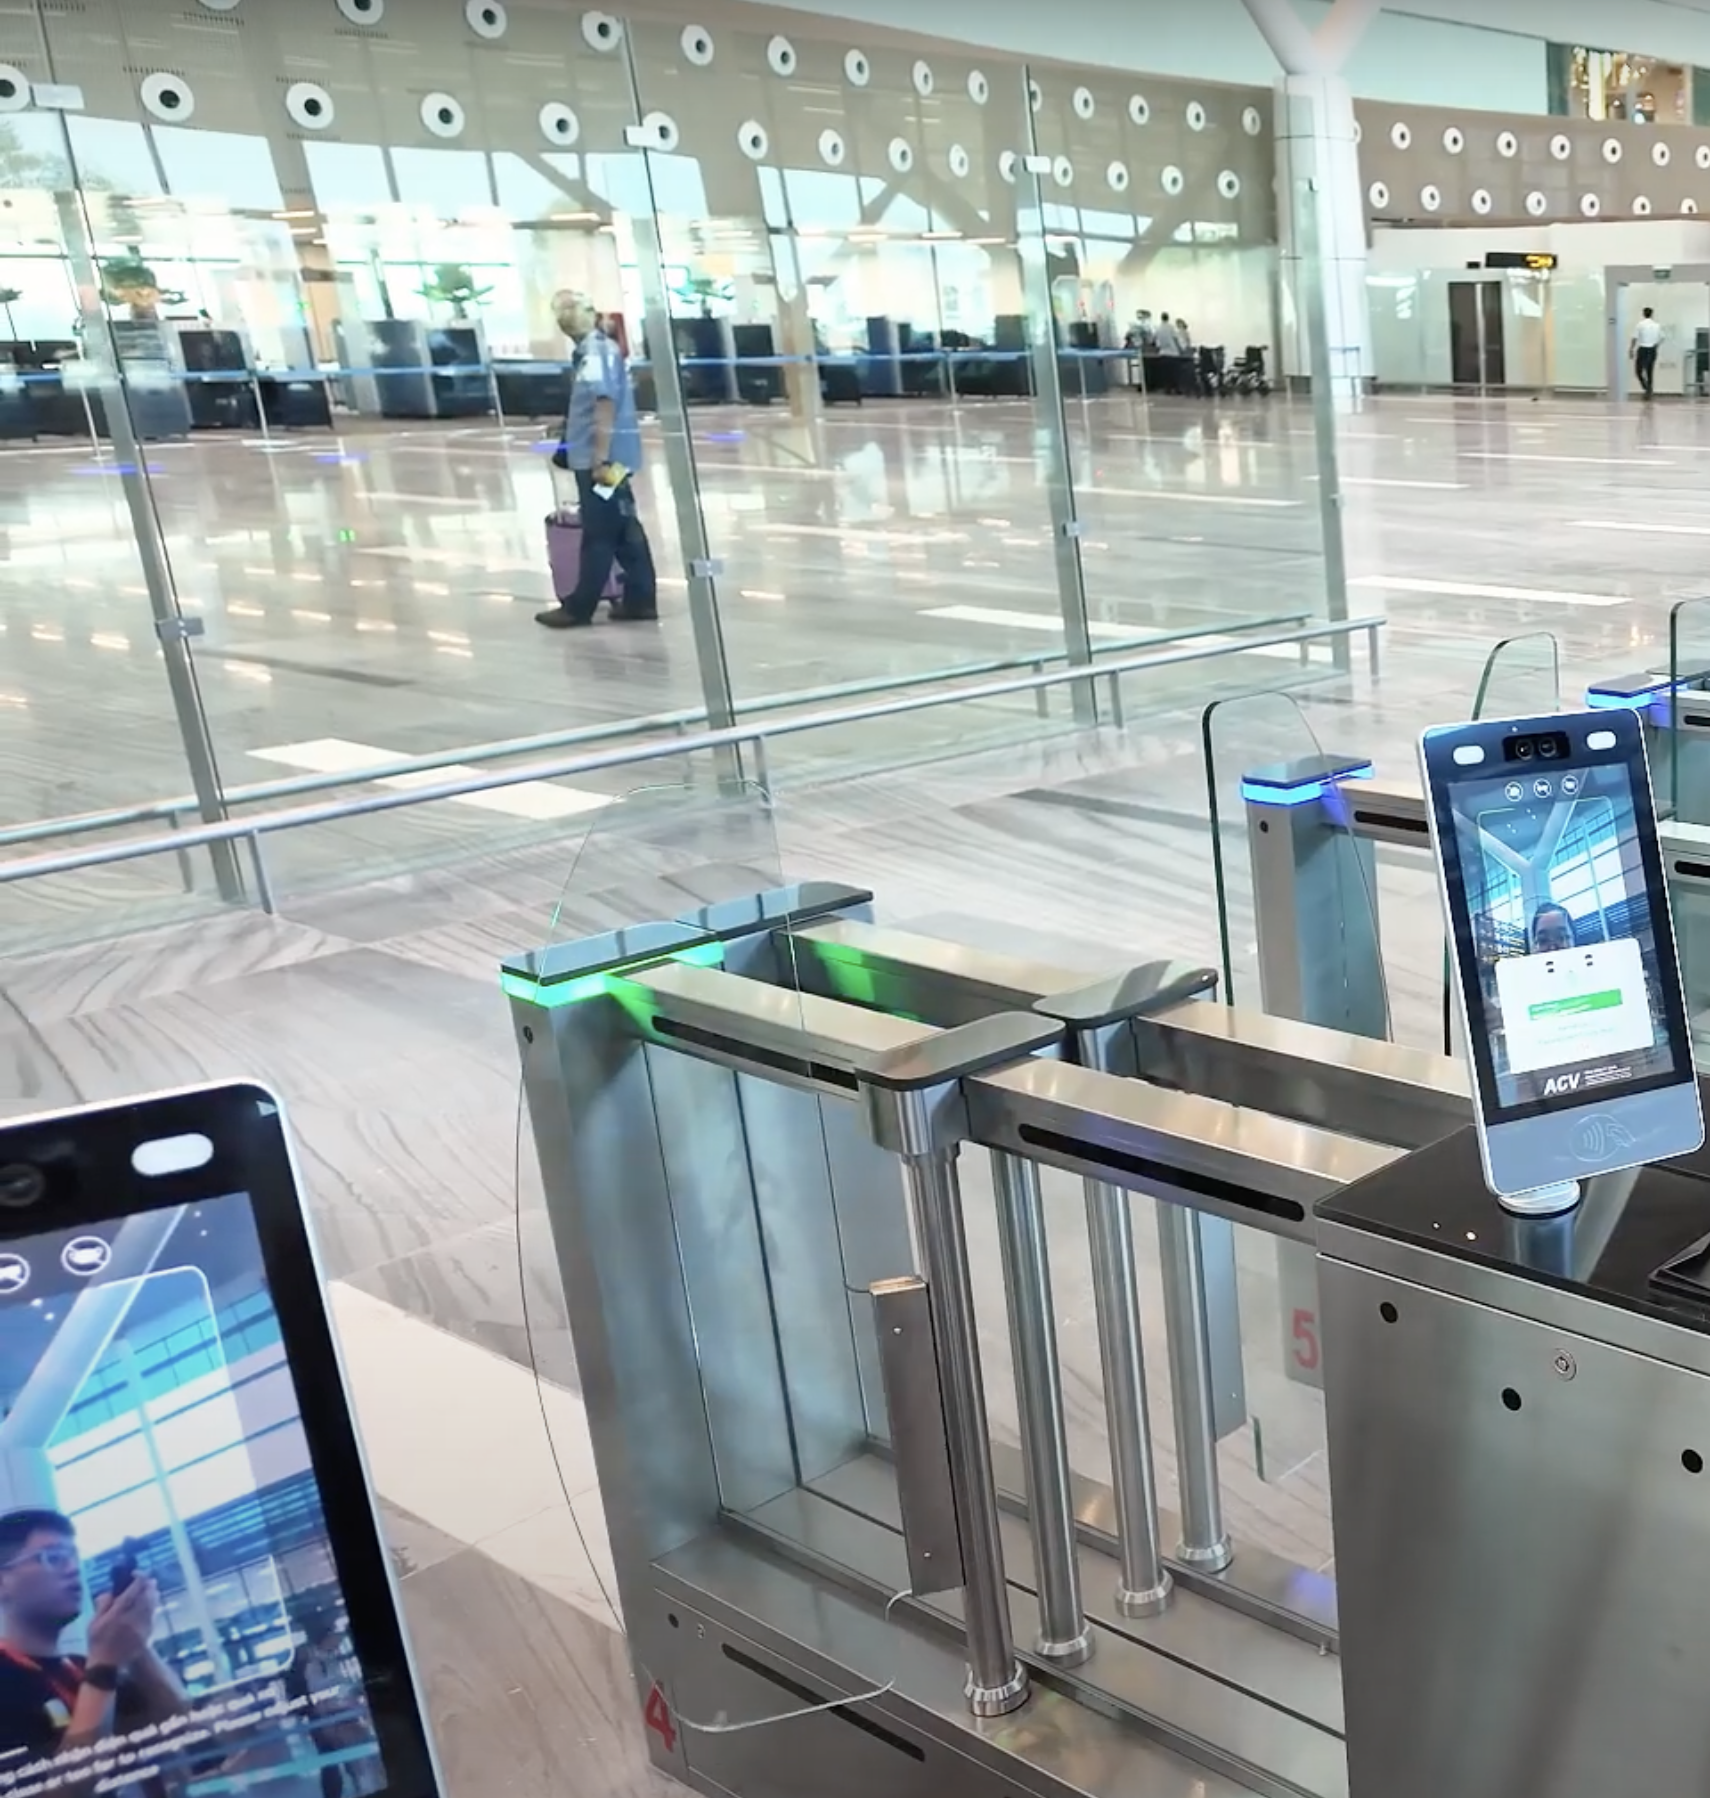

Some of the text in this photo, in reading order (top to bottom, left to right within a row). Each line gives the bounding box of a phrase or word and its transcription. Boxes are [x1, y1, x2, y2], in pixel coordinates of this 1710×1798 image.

[1544, 1072, 1581, 1096] ACV
[1292, 1308, 1319, 1370] 5
[309, 1685, 340, 1706] your
[645, 1679, 677, 1753] 4
